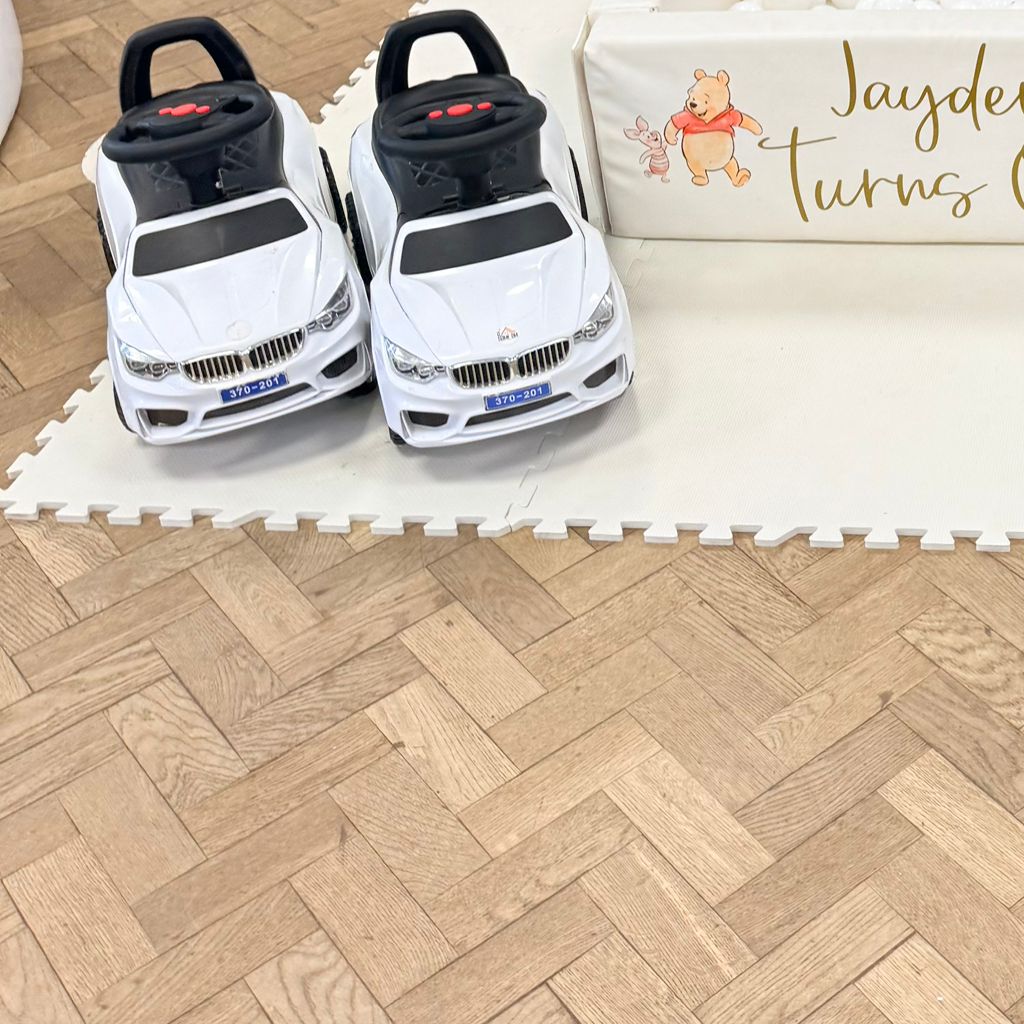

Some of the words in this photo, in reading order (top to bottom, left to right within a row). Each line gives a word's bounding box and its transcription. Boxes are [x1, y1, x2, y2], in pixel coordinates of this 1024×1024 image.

[757, 126, 989, 223] Turns
[229, 376, 279, 398] 370-201
[495, 386, 543, 406] 370-201
